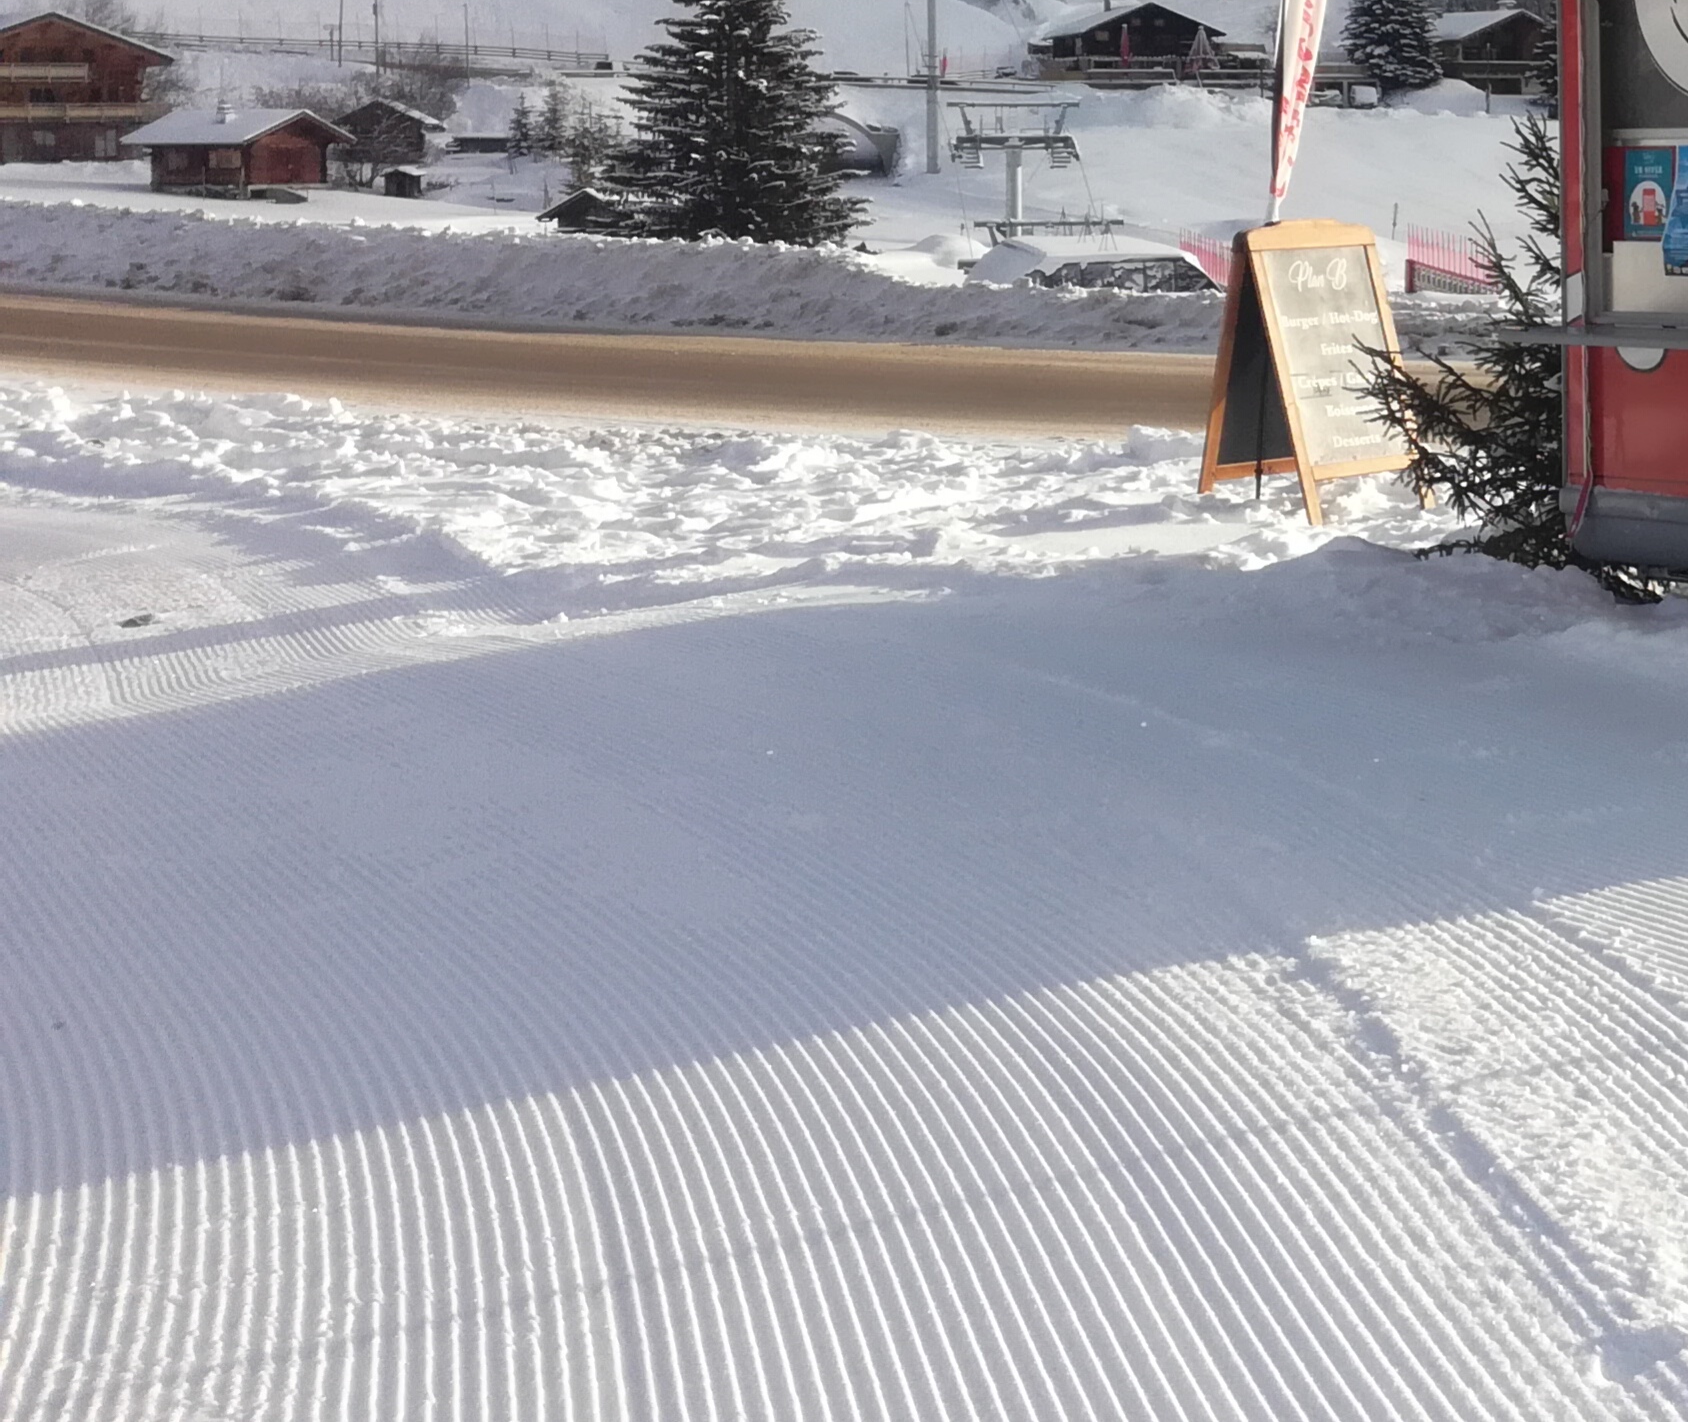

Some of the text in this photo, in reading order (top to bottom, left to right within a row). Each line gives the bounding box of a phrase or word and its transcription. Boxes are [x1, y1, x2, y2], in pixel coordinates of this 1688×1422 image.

[1288, 257, 1348, 292] Plan B
[1281, 315, 1319, 330] Burger
[1329, 310, 1378, 324] Hot-Dog
[1320, 343, 1353, 355] Frites
[1297, 374, 1337, 390] Crêpes
[1332, 433, 1382, 448] Desserts
